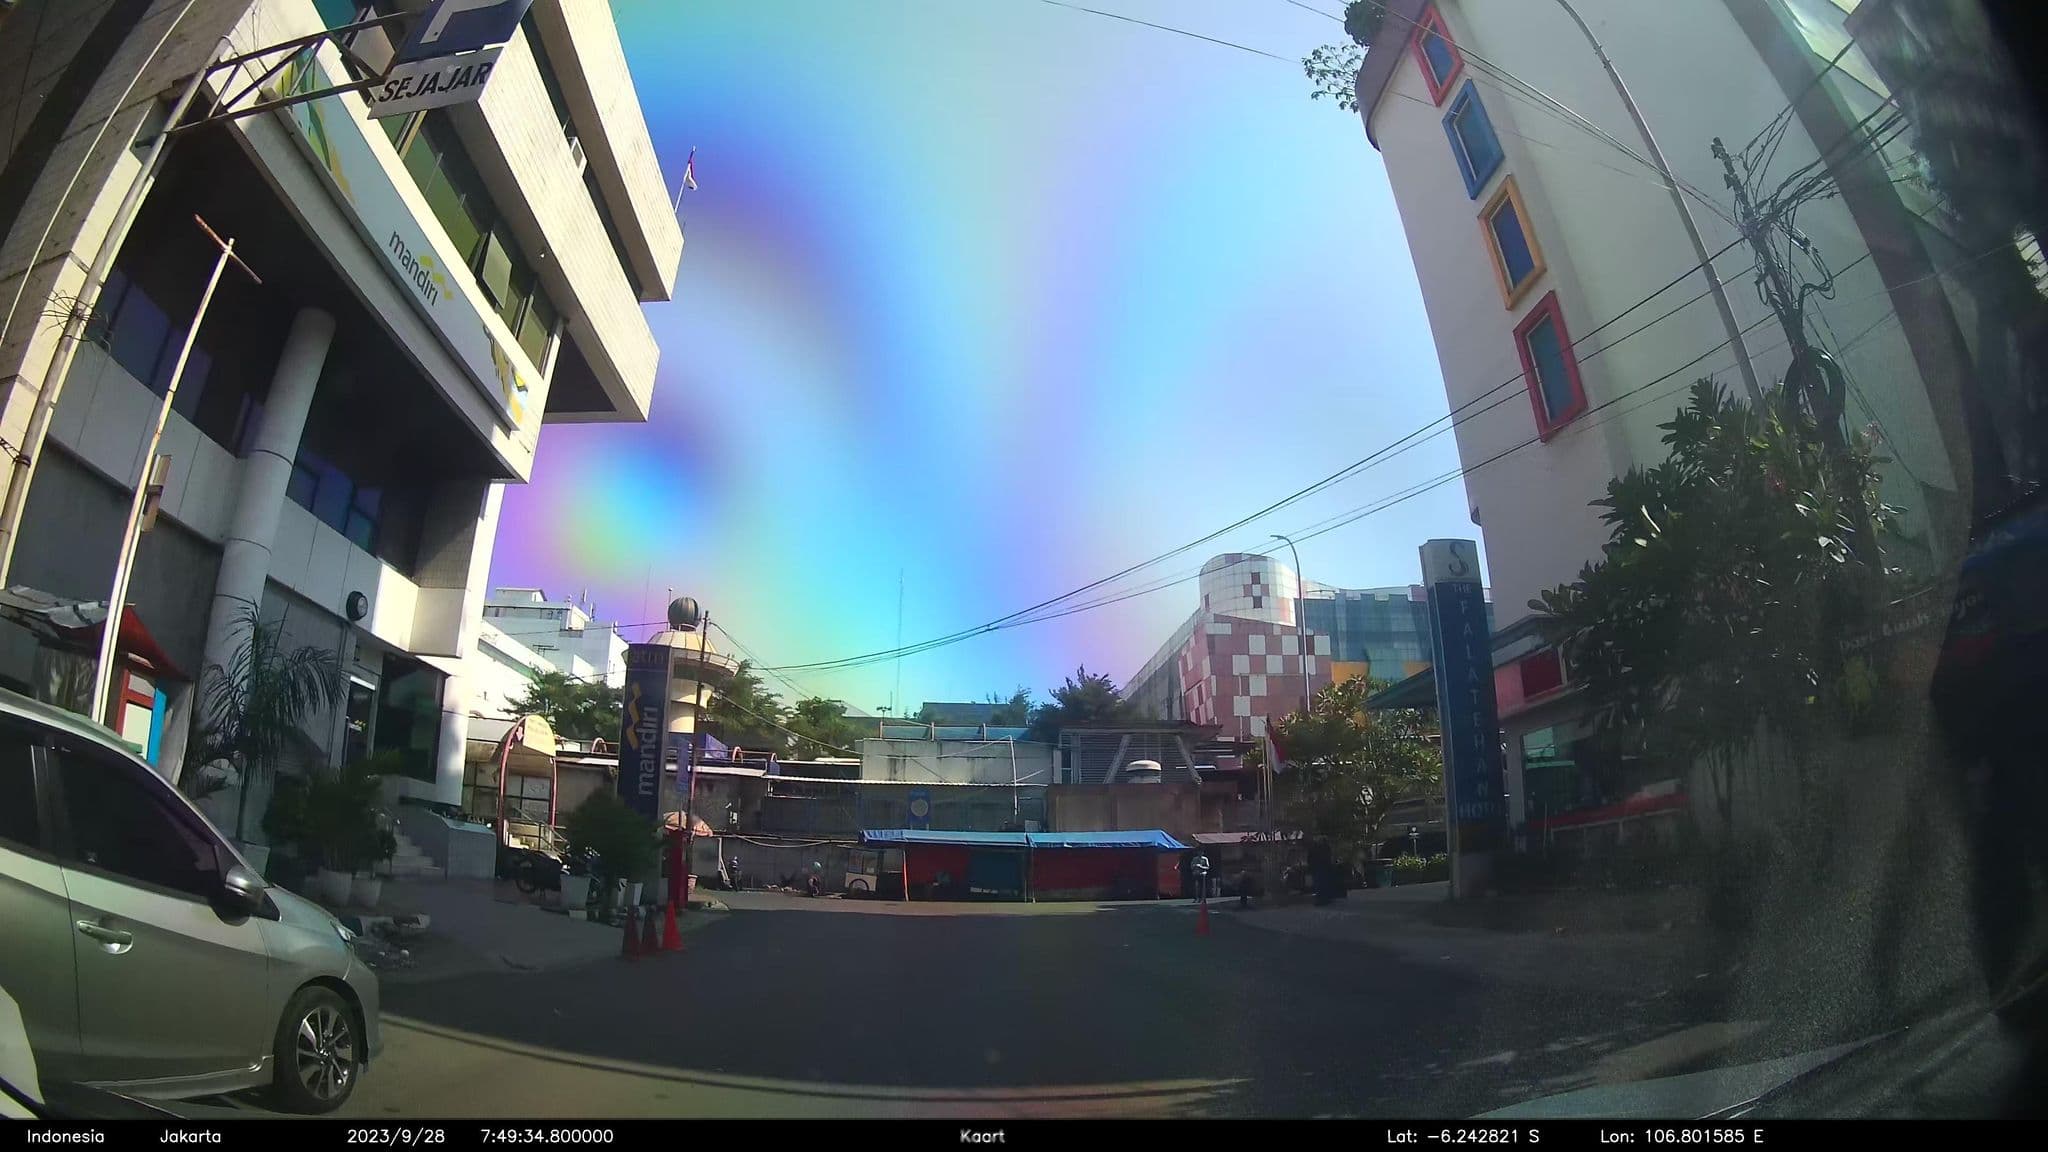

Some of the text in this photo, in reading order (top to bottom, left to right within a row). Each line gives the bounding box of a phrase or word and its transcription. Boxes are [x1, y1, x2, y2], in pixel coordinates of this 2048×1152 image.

[379, 62, 493, 102] SEJAJAR
[389, 231, 438, 306] mandiri
[1453, 583, 1473, 594] THE
[637, 706, 658, 796] mandiri
